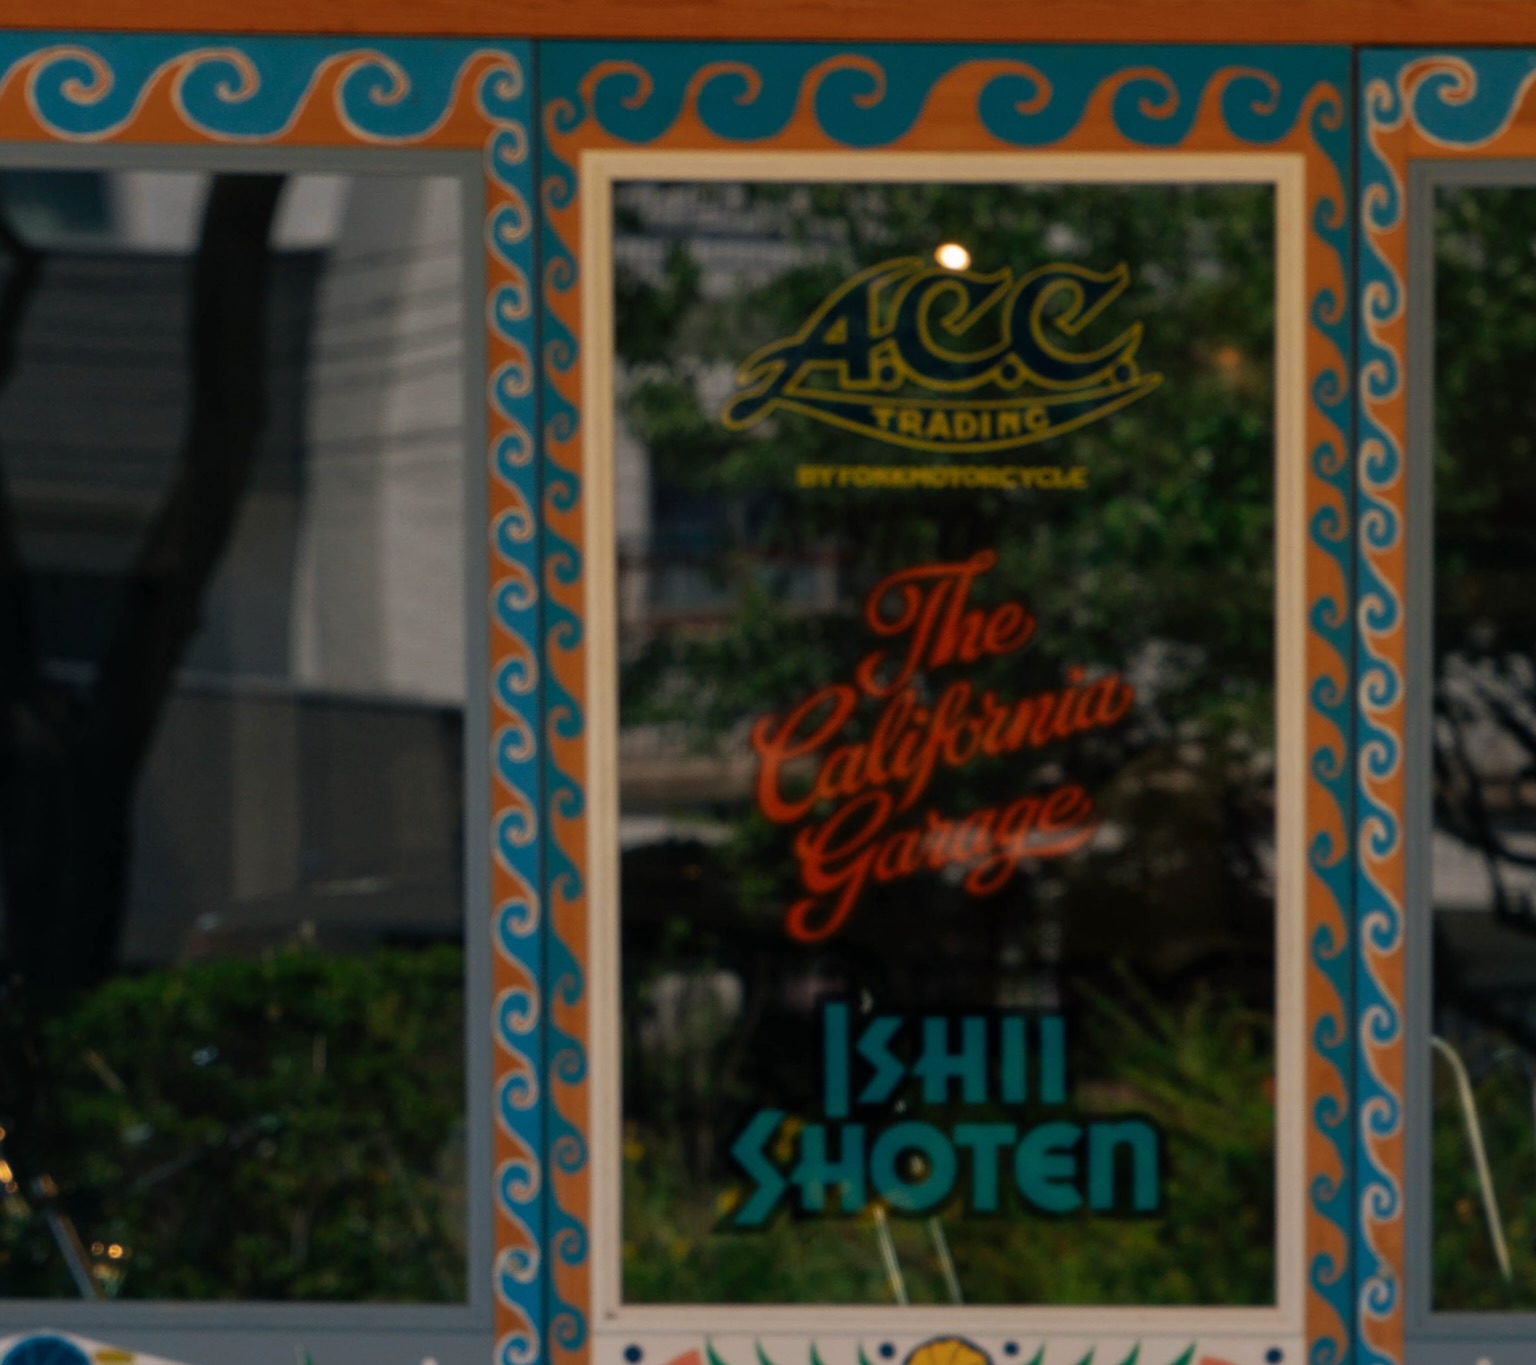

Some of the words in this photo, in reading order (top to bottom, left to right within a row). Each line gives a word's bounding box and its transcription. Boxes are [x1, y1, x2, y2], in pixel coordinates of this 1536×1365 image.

[873, 407, 1050, 440] TRADING
[856, 549, 1036, 696] The
[751, 664, 1135, 823] California
[785, 785, 1099, 942] Garage
[823, 1002, 1067, 1118] ISHII
